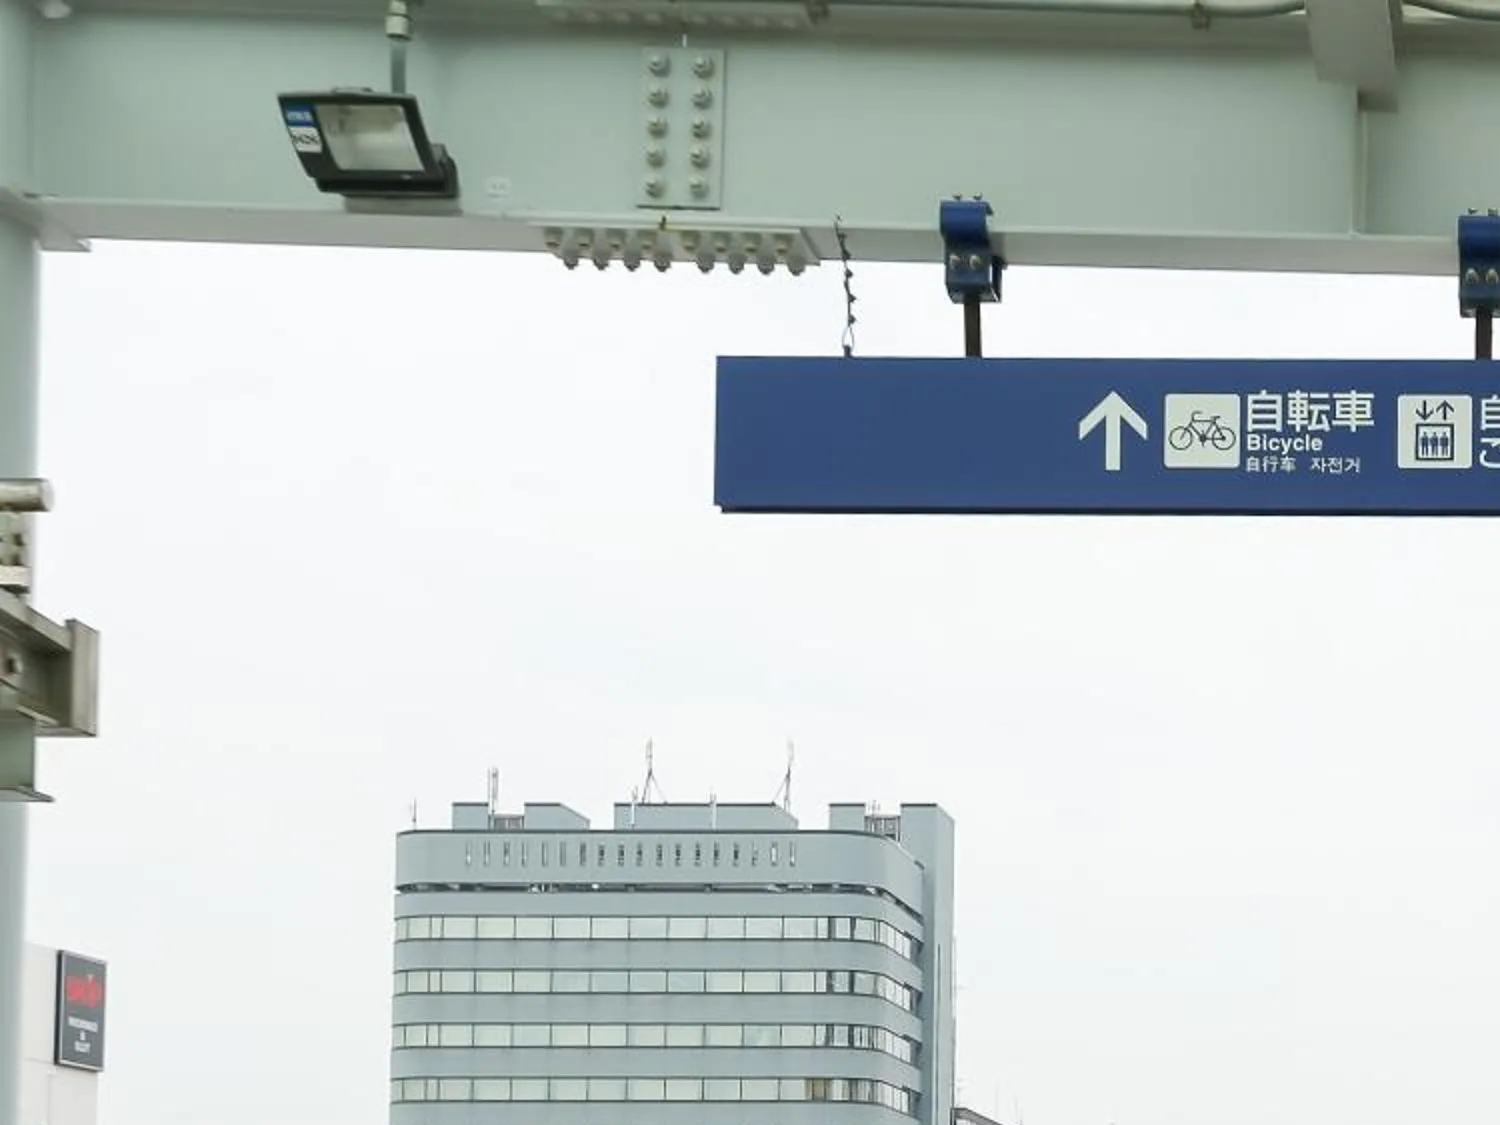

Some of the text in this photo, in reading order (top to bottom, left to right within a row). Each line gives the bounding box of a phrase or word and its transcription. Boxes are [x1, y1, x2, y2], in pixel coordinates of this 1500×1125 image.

[1247, 389, 1375, 433] 自転車
[1246, 433, 1324, 455] Bicycle
[1311, 456, 1361, 474] 자전거
